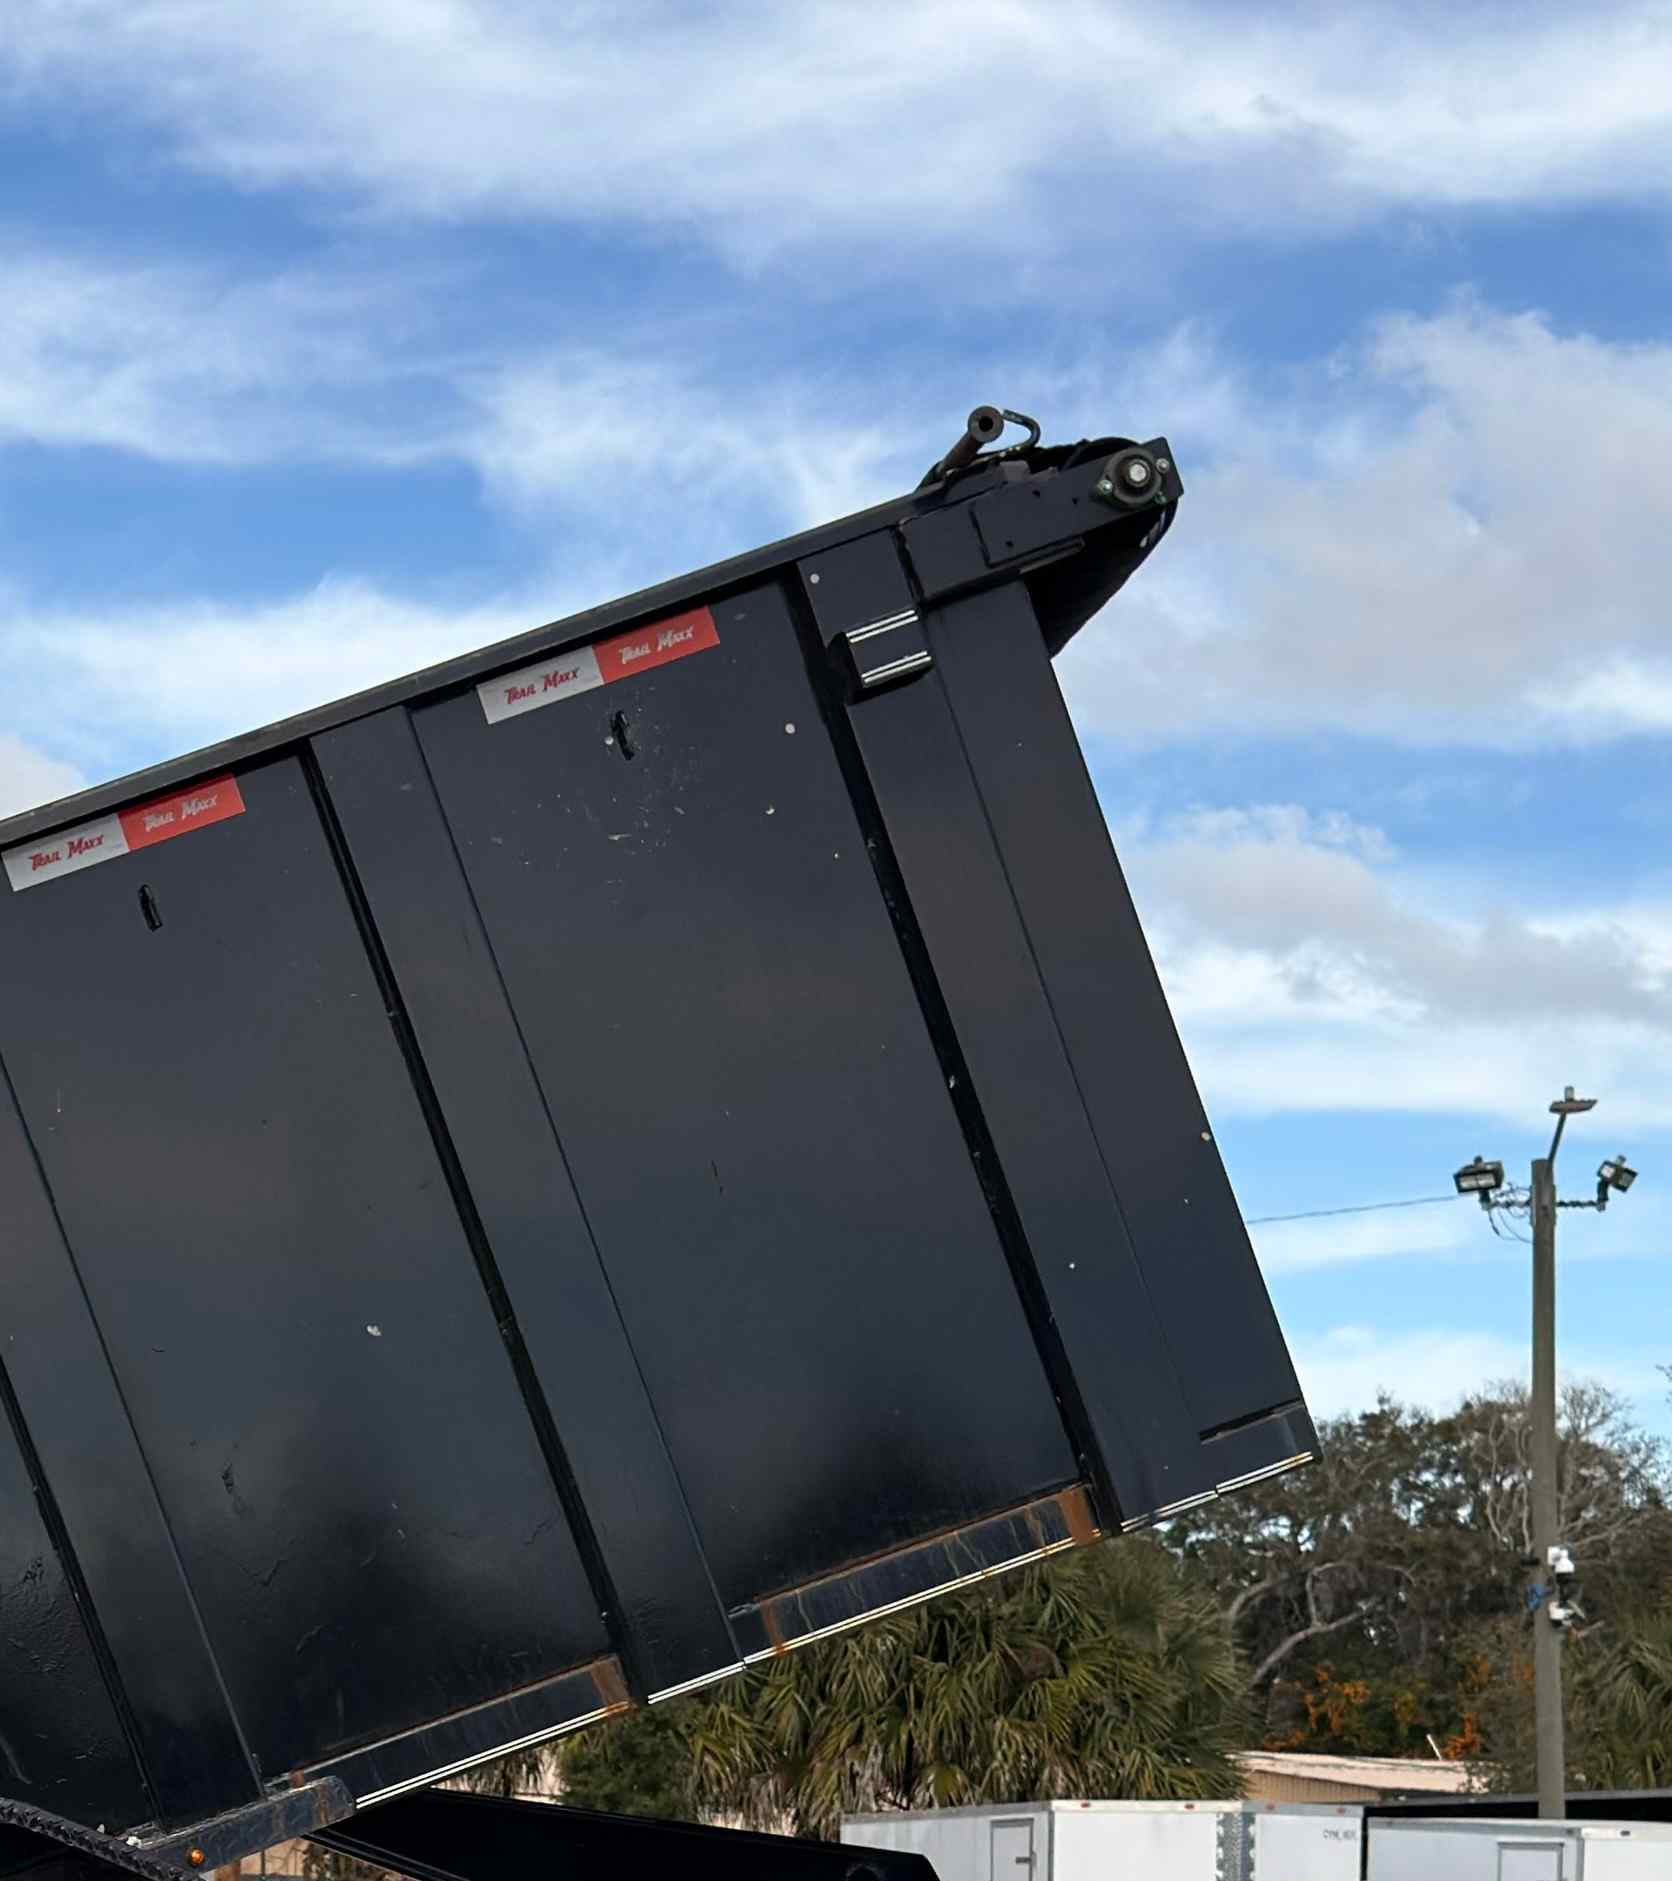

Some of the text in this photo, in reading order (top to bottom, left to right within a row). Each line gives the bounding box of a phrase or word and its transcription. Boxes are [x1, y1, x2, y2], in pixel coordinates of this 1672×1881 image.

[618, 626, 695, 664] TRAIL MAXX
[504, 666, 580, 704] TRAIL MAXX
[144, 794, 219, 832] TRAIL MAXX
[28, 834, 105, 871] TRAIL MAXX
